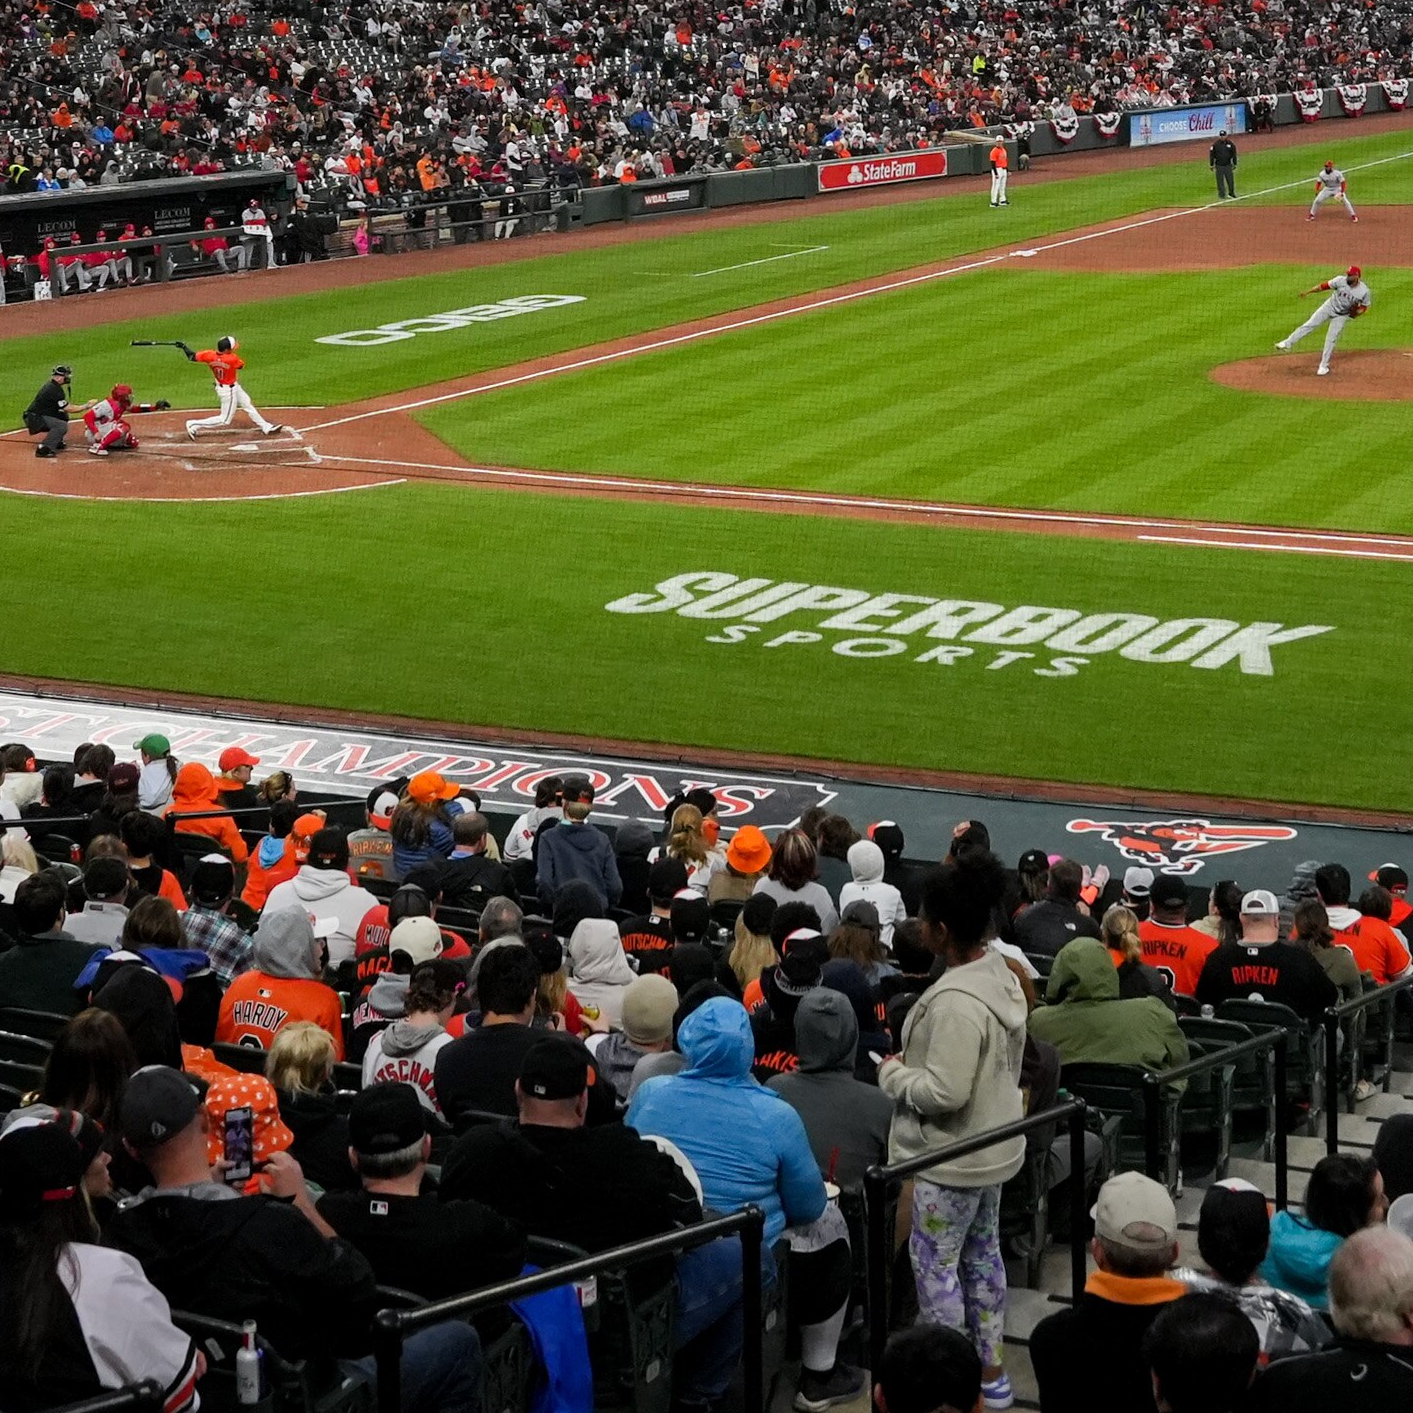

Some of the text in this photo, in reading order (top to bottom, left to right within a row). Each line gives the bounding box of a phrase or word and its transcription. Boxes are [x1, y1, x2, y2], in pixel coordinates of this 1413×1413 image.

[1159, 112, 1216, 133] CHOOSE Chill
[314, 294, 588, 346] GEICO
[605, 570, 1337, 677] SUPERBOOK
[705, 624, 1090, 677] SPORTS
[89, 718, 776, 817] CHAMPIONS
[1141, 939, 1188, 960] RIPKEN
[1231, 965, 1278, 987] RIPKEN
[233, 1000, 288, 1033] HARDY
